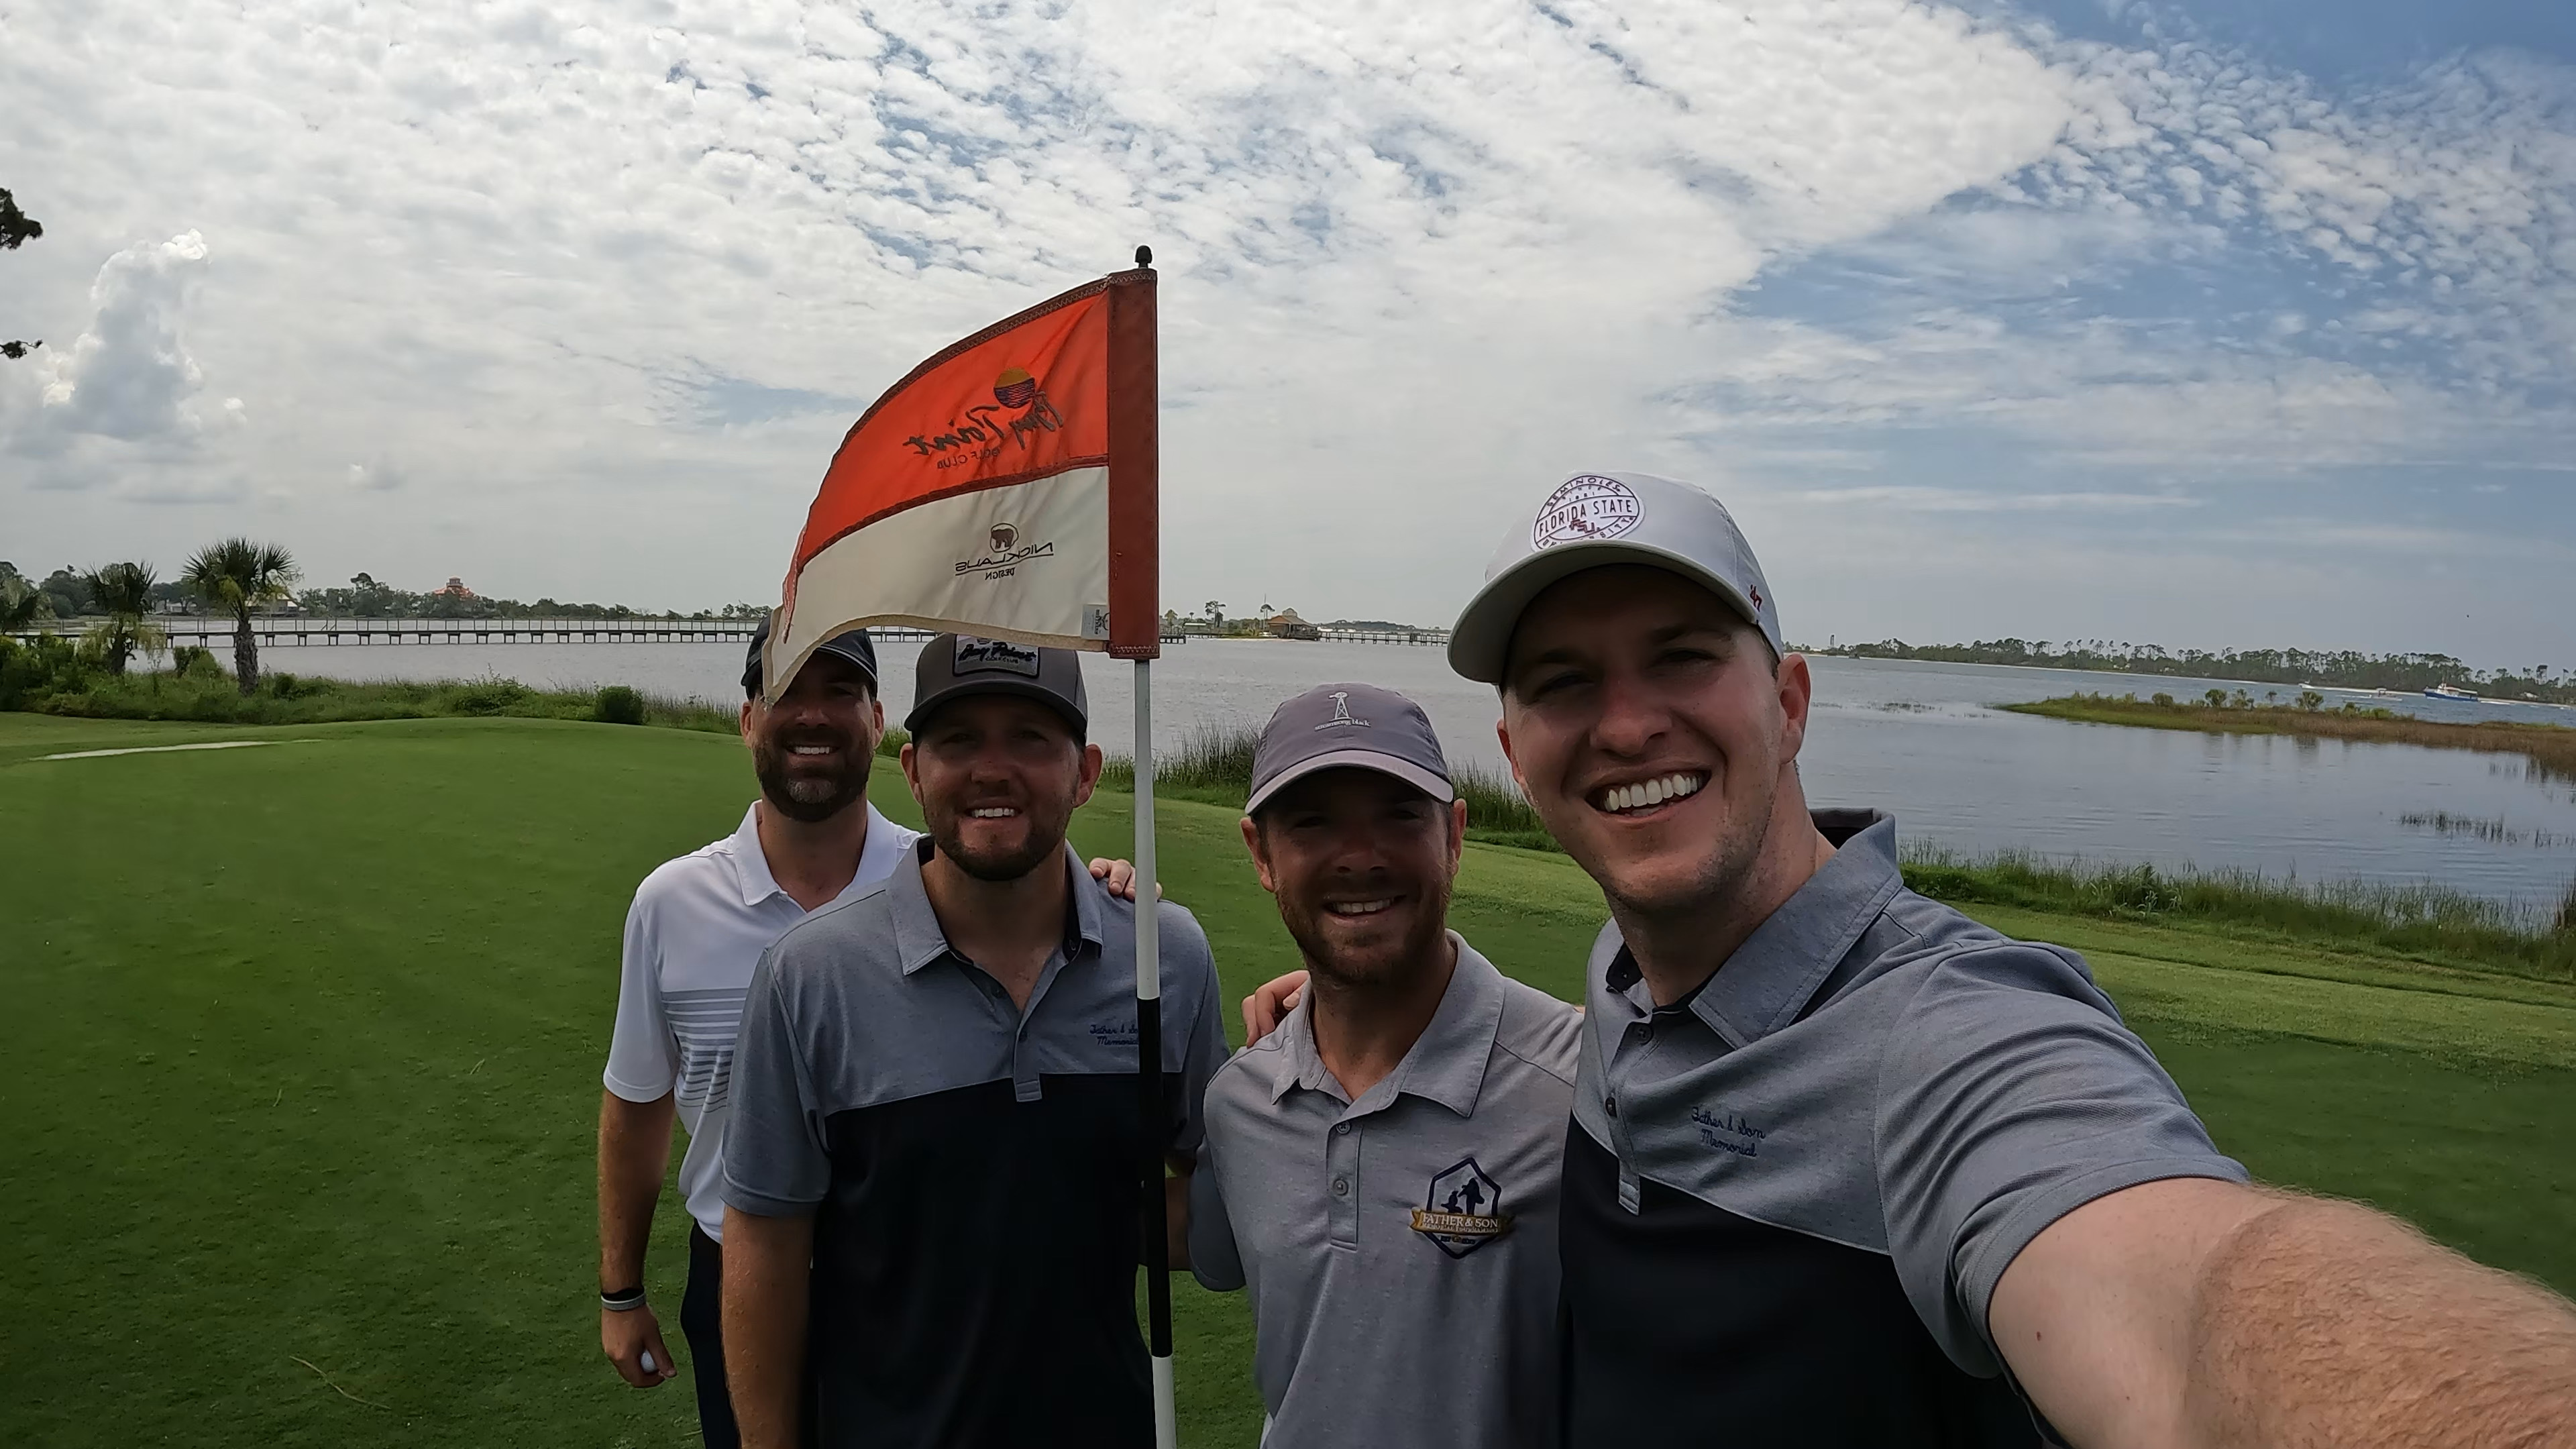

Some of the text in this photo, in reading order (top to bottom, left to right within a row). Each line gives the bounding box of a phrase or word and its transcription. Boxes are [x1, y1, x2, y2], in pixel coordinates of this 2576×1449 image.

[1538, 498, 1633, 537] FLORIDA STATE
[957, 641, 1037, 662] Bay Point
[1089, 1024, 1117, 1034] Father
[1128, 1024, 1138, 1034] So
[1097, 1036, 1138, 1046] Memoria
[1691, 1106, 1766, 1139] Father & Son
[1701, 1128, 1758, 1157] Memorial
[1423, 1212, 1498, 1228] FATHER & SON
